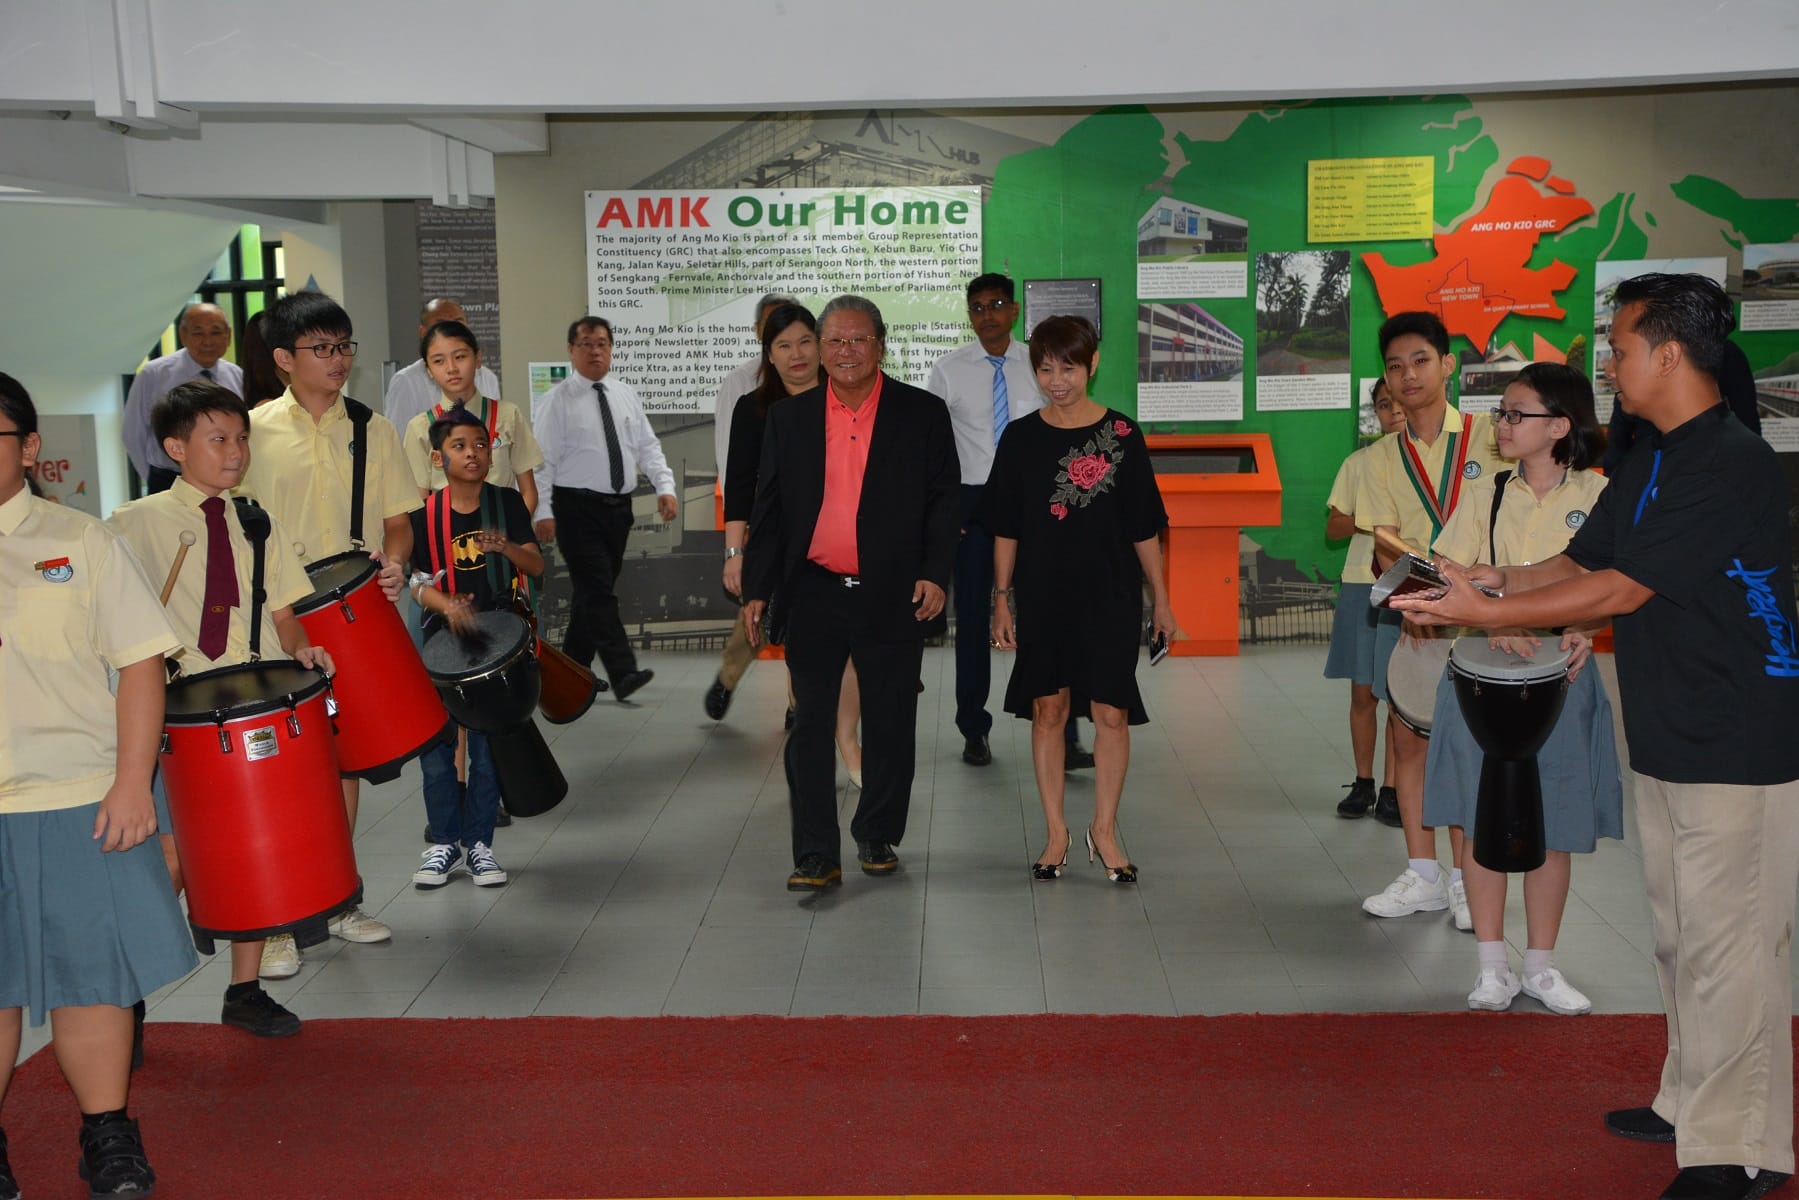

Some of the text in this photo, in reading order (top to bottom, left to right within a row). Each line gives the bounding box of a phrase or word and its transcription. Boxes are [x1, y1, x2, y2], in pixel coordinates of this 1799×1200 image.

[596, 194, 969, 228] AMK Our Home
[1471, 219, 1556, 232] ANG MO KIO GRC
[596, 235, 614, 243] The
[619, 234, 661, 245] majority
[666, 234, 677, 243] of
[682, 234, 701, 244] Ang
[704, 234, 720, 242] Mo
[722, 234, 739, 242] Kio
[743, 234, 752, 242] is
[754, 234, 775, 244] part
[777, 233, 788, 242] of
[803, 232, 817, 241] six
[822, 232, 863, 241] member
[868, 231, 899, 242] Group
[902, 230, 978, 240] Representation
[596, 243, 978, 258] Constituency (GRC) that also encompasses Teck Ghee, Kebun Baru, Yio Chu
[597, 261, 625, 271] Kang,
[628, 261, 653, 269] Jalan
[687, 260, 721, 269] Seletar
[725, 260, 749, 270] Hills,
[752, 260, 773, 270] part
[775, 259, 785, 268] of
[788, 259, 842, 269] Serangoon
[845, 258, 877, 268] North,
[880, 258, 896, 266] the
[899, 258, 938, 266] western
[941, 257, 978, 267] portion
[597, 274, 608, 282] of
[610, 273, 660, 283] Sengkang
[669, 273, 714, 283] Fernvale,
[717, 272, 773, 281] Anchorvale
[776, 272, 794, 281] and
[798, 272, 814, 280] the
[816, 271, 861, 280] southern
[864, 271, 902, 281] portion
[905, 270, 915, 279] of
[917, 270, 951, 278] Yishun
[959, 269, 979, 278] Nee
[598, 287, 623, 295] Soon
[661, 286, 690, 294] Prime
[693, 286, 734, 294] Minister
[736, 285, 753, 294] Lee
[756, 285, 784, 294] Hsien
[787, 285, 818, 295] Loong
[821, 284, 829, 293] is
[832, 284, 848, 293] the
[850, 284, 892, 292] Member
[895, 283, 905, 292] of
[907, 282, 961, 292] Parliament
[598, 299, 643, 308] this GRC.
[611, 325, 631, 335] day,
[635, 325, 655, 335] Ang
[658, 325, 674, 333] Mo
[677, 325, 694, 333] Kio
[697, 324, 705, 333] is
[708, 324, 725, 333] the
[893, 321, 927, 331] people
[930, 321, 975, 330] (Statistic
[655, 338, 708, 346] Newsletter
[713, 337, 741, 346] 2009)
[912, 335, 959, 344] including
[612, 351, 629, 361] wly
[633, 351, 681, 360] improved
[686, 350, 709, 358] AMK
[713, 350, 733, 358] Hub
[900, 348, 919, 356] first
[647, 364, 670, 373] Xtra,
[694, 363, 710, 373] key
[902, 361, 922, 371] Ang
[641, 376, 666, 386] Kang
[669, 376, 687, 384] and
[699, 376, 716, 384] Bus
[903, 373, 925, 382] MRT
